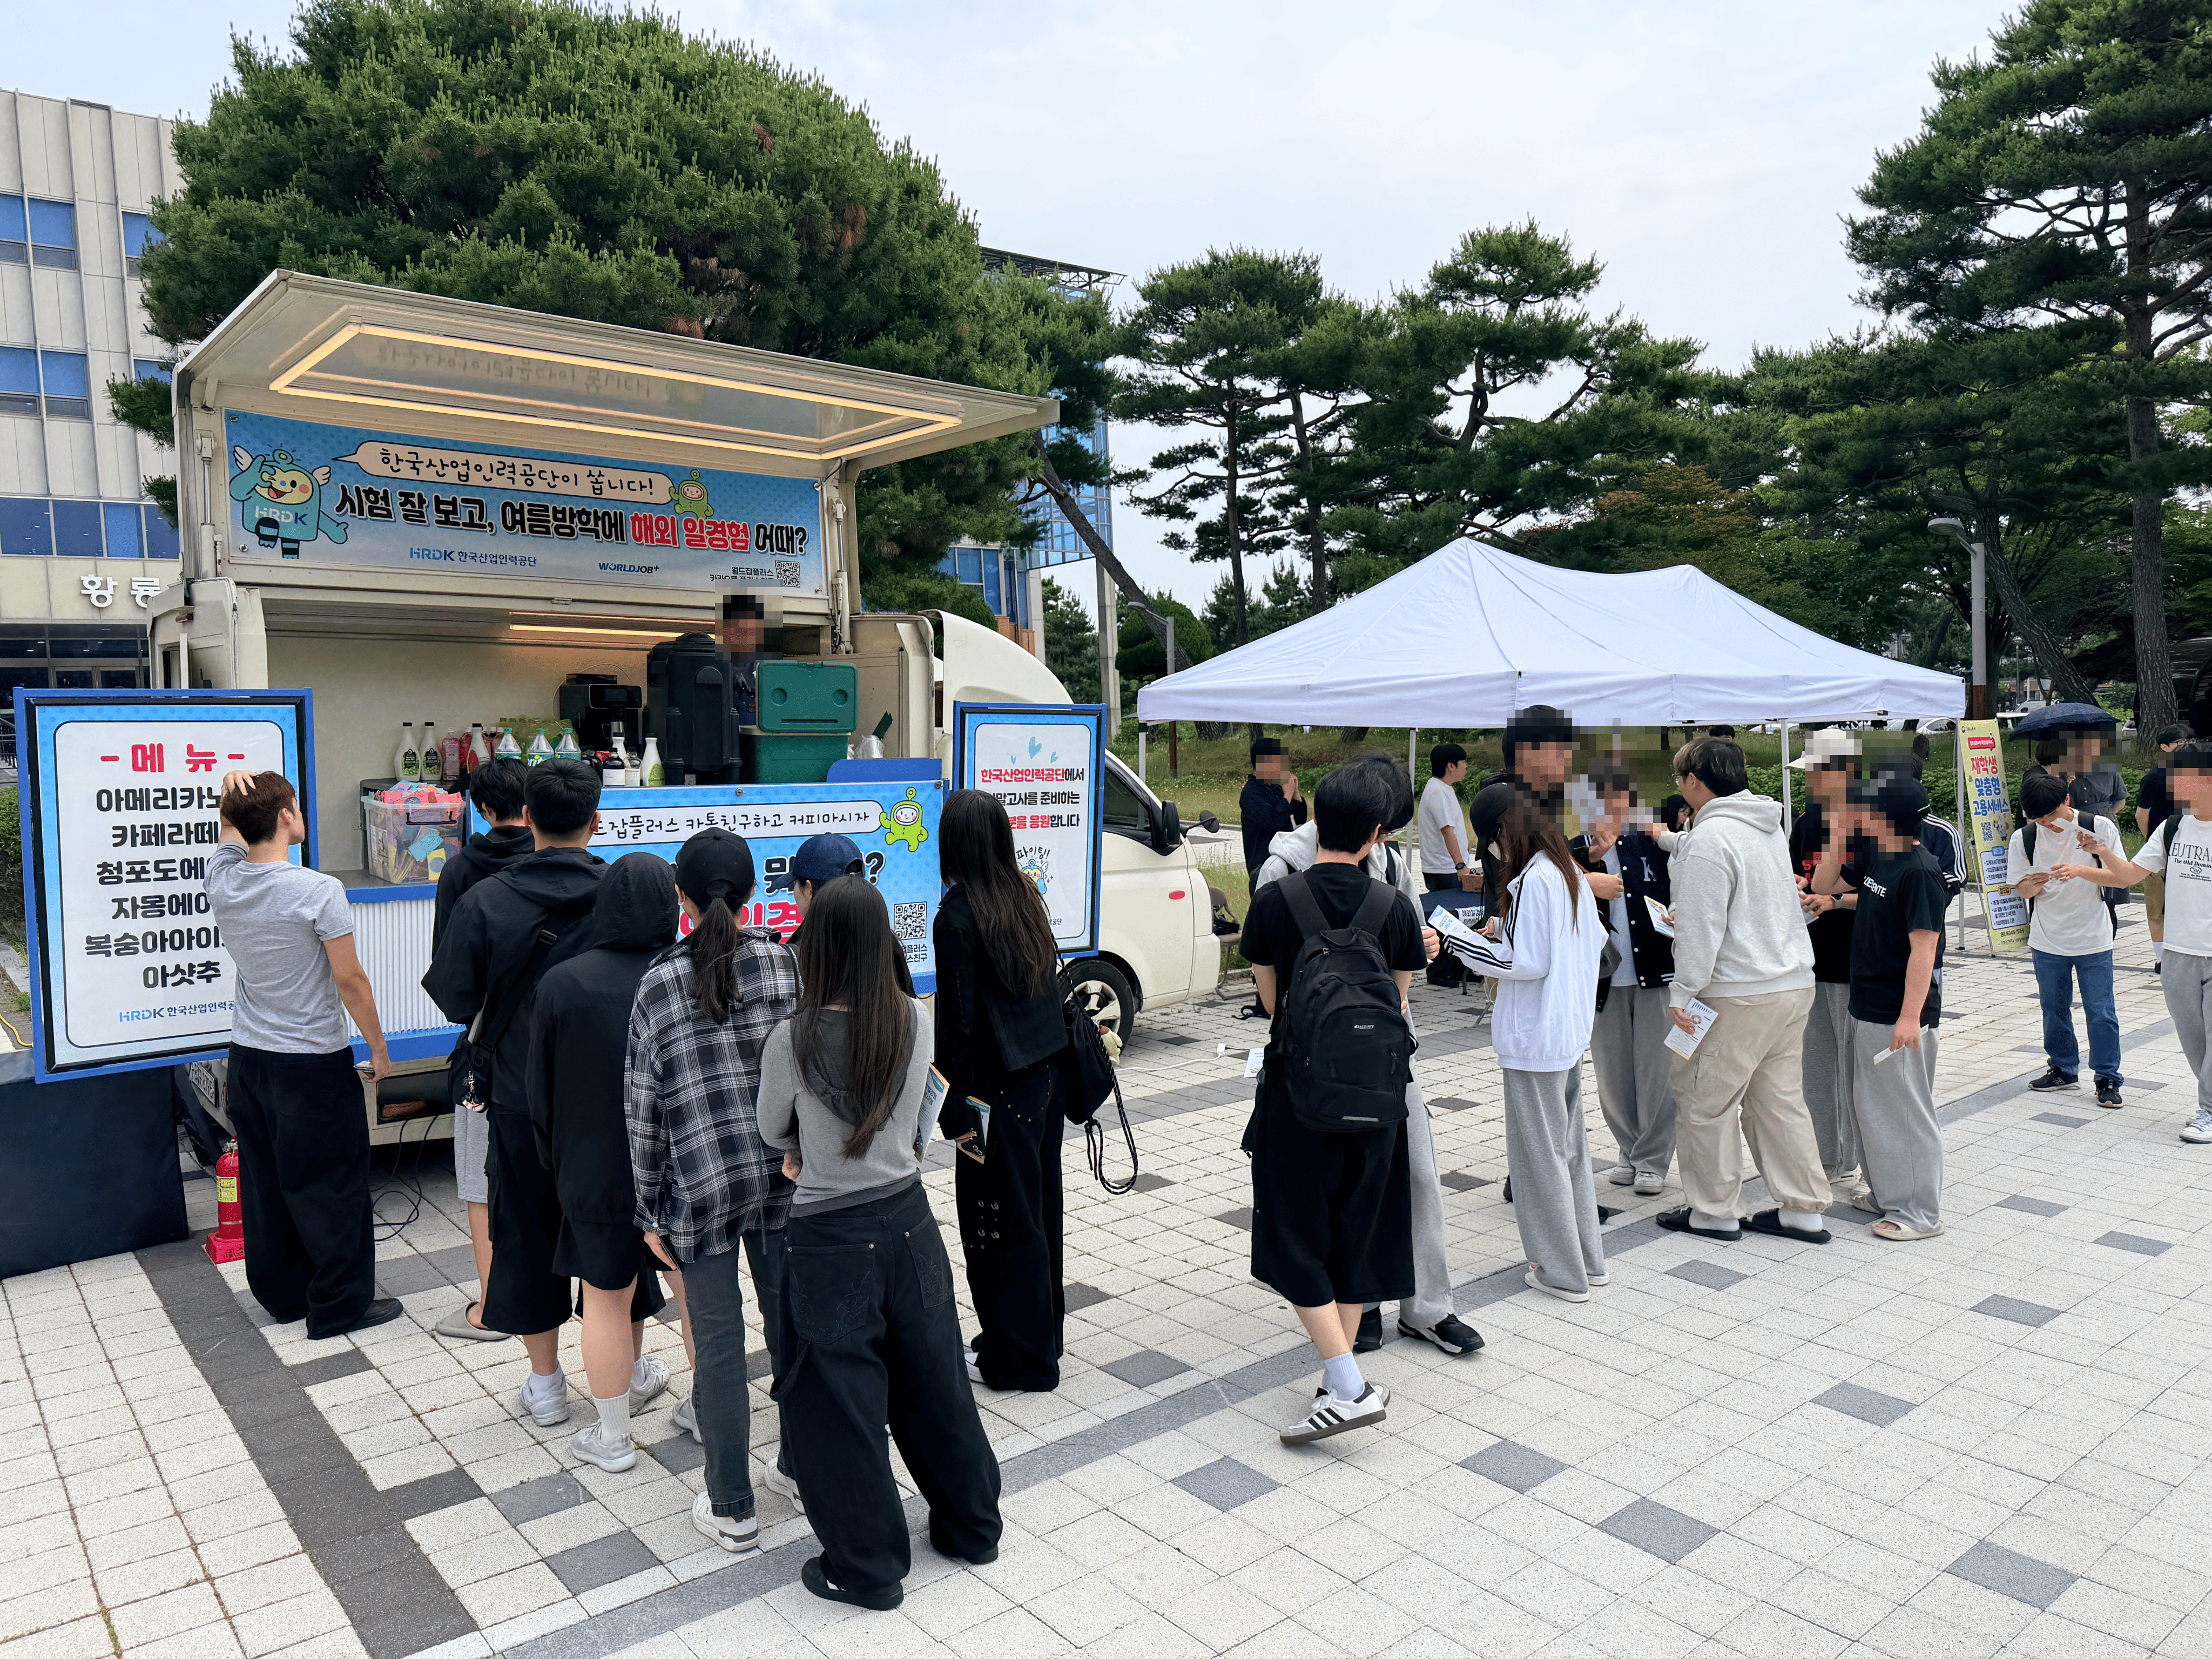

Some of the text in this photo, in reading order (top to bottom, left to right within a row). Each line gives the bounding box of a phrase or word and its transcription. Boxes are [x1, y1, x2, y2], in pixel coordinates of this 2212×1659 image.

[380, 448, 653, 495] 한국산업인력공단이 쏩니다!
[335, 485, 808, 555] 시험 잘 보고, 여름방학에 해외 일경험 어때?
[410, 548, 537, 567] HRDK 한국산업인력공단
[731, 567, 774, 576] 월드잡플러스
[1971, 755, 1998, 774] 재학생
[981, 768, 1084, 783] 한국산업인력공단에서
[1975, 777, 2001, 797] 맞춤형
[993, 791, 1080, 806] 말고사를 준비하는
[1973, 798, 2009, 816] 고용서비스
[790, 812, 869, 825] 커피마시자
[1029, 814, 1080, 828] 응원합니다
[112, 822, 219, 848] 카페라떼
[1016, 846, 1050, 859] 파이팅!
[2169, 842, 2212, 862] EUTRA
[96, 858, 211, 886] 청포도에
[1640, 857, 1657, 882] K
[85, 928, 225, 958] 복숭아아이
[903, 943, 927, 953] 플러스
[143, 960, 220, 989] 아샷추
[119, 1000, 234, 1022] HRDK 한국산업인력공
